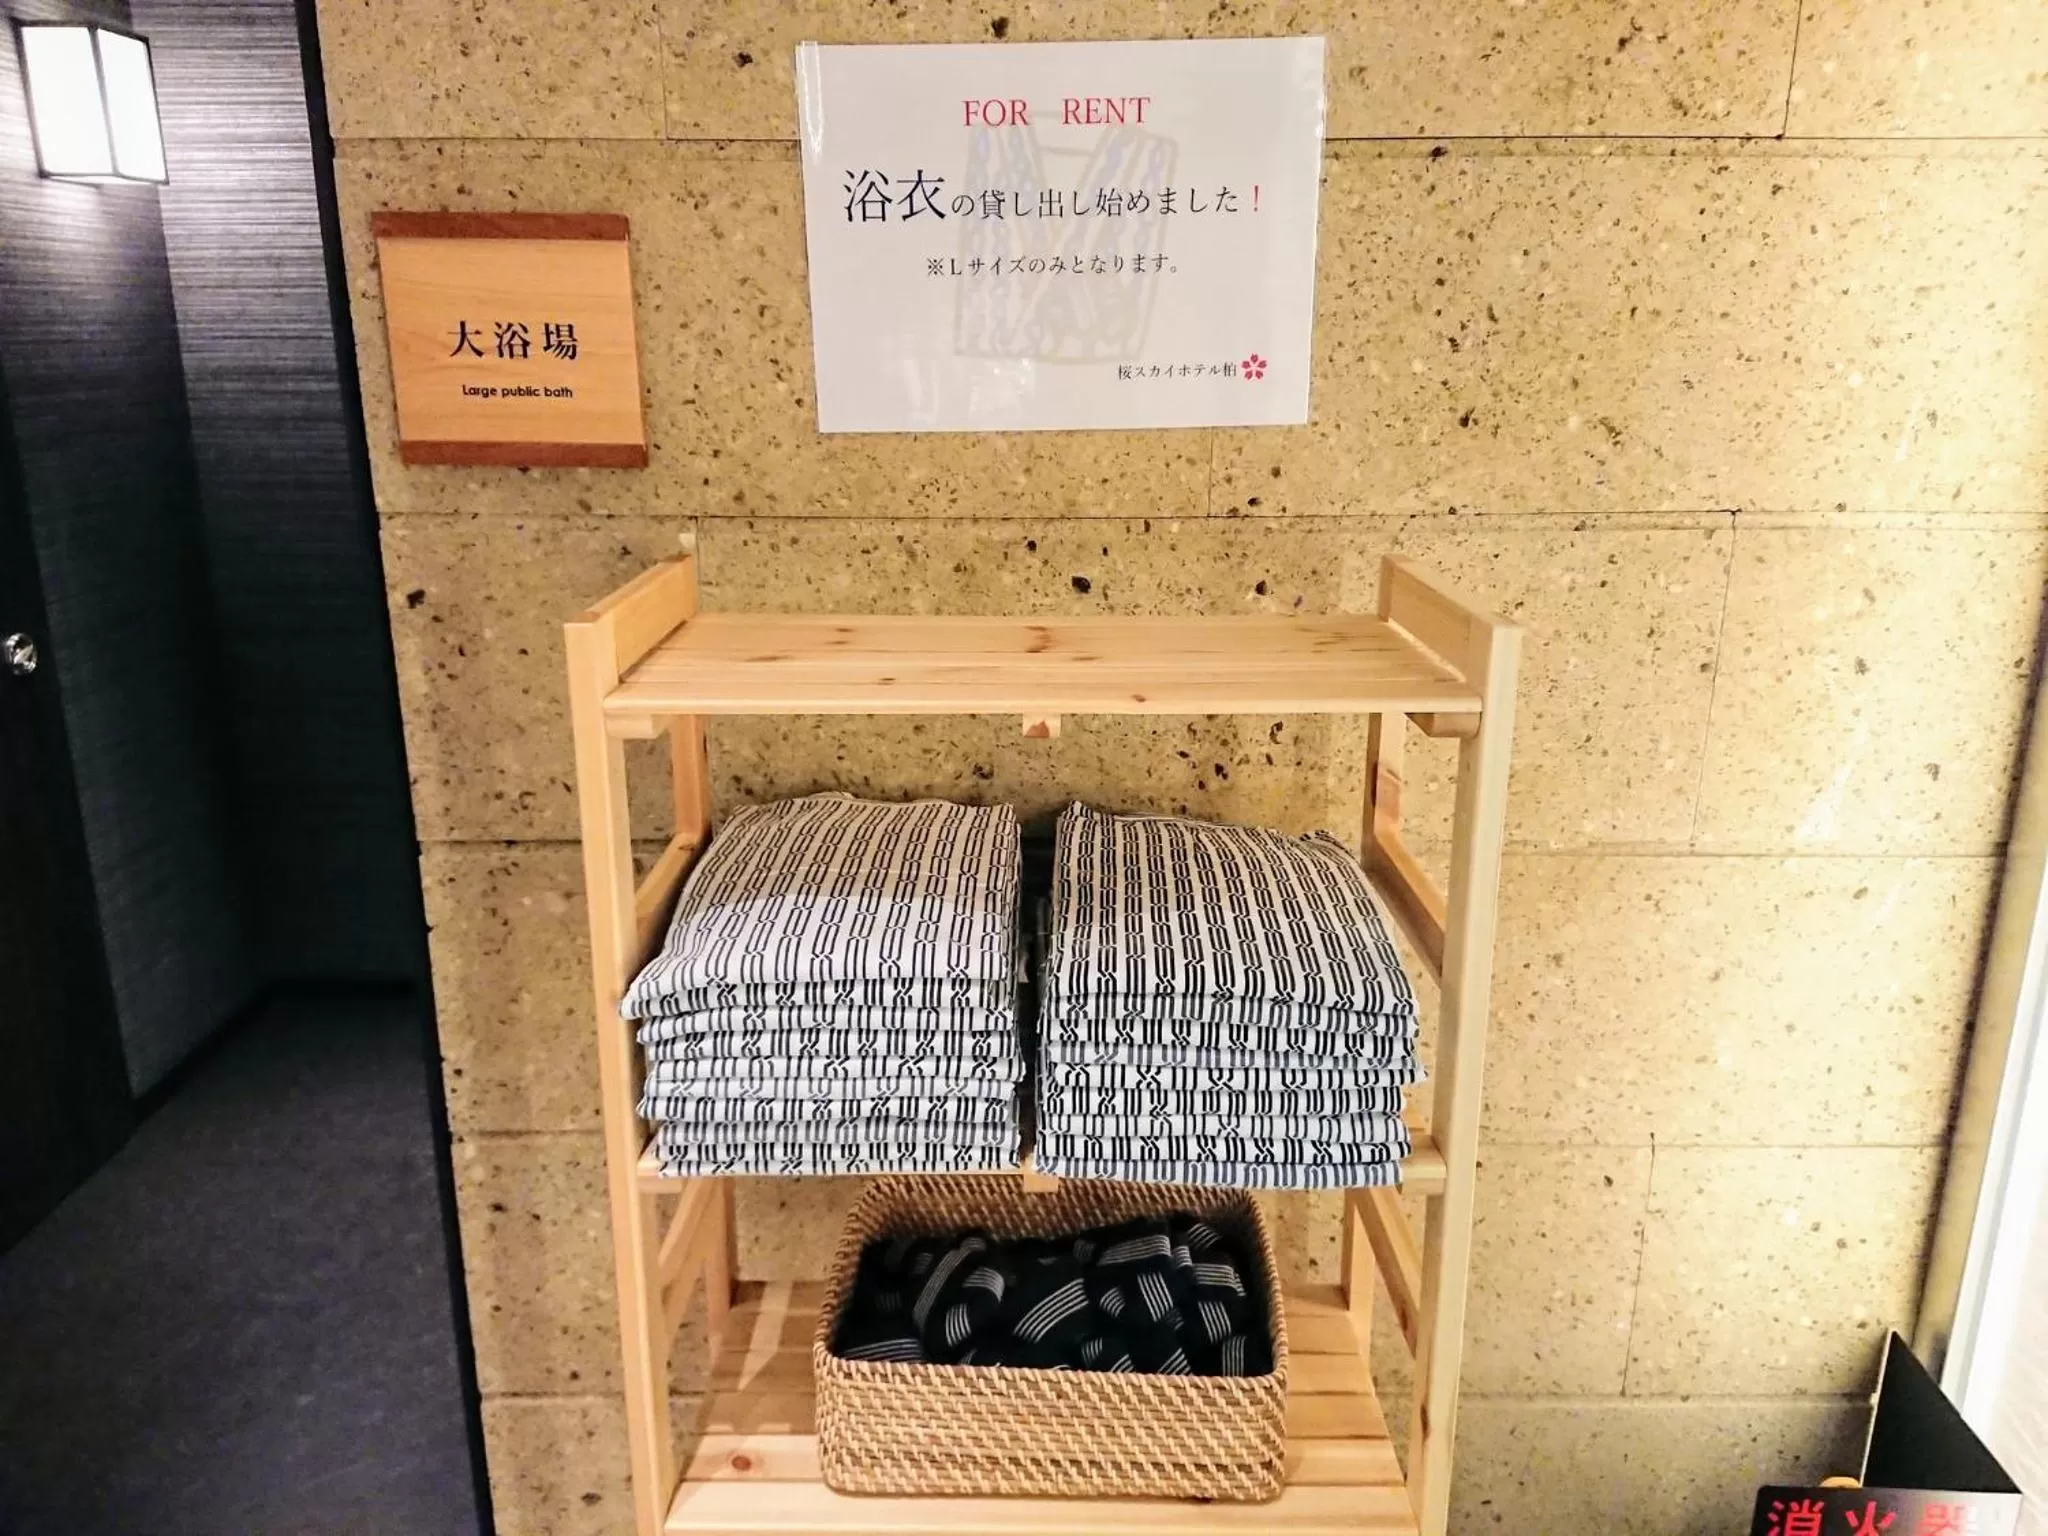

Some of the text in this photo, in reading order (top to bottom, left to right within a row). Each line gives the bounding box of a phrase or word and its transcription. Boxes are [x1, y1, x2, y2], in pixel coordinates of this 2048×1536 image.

[962, 96, 1151, 127] FOR RENT
[446, 320, 579, 360] 大浴場
[1118, 361, 1237, 380] 桜スカイホテル柏
[462, 384, 573, 398] Large public bath
